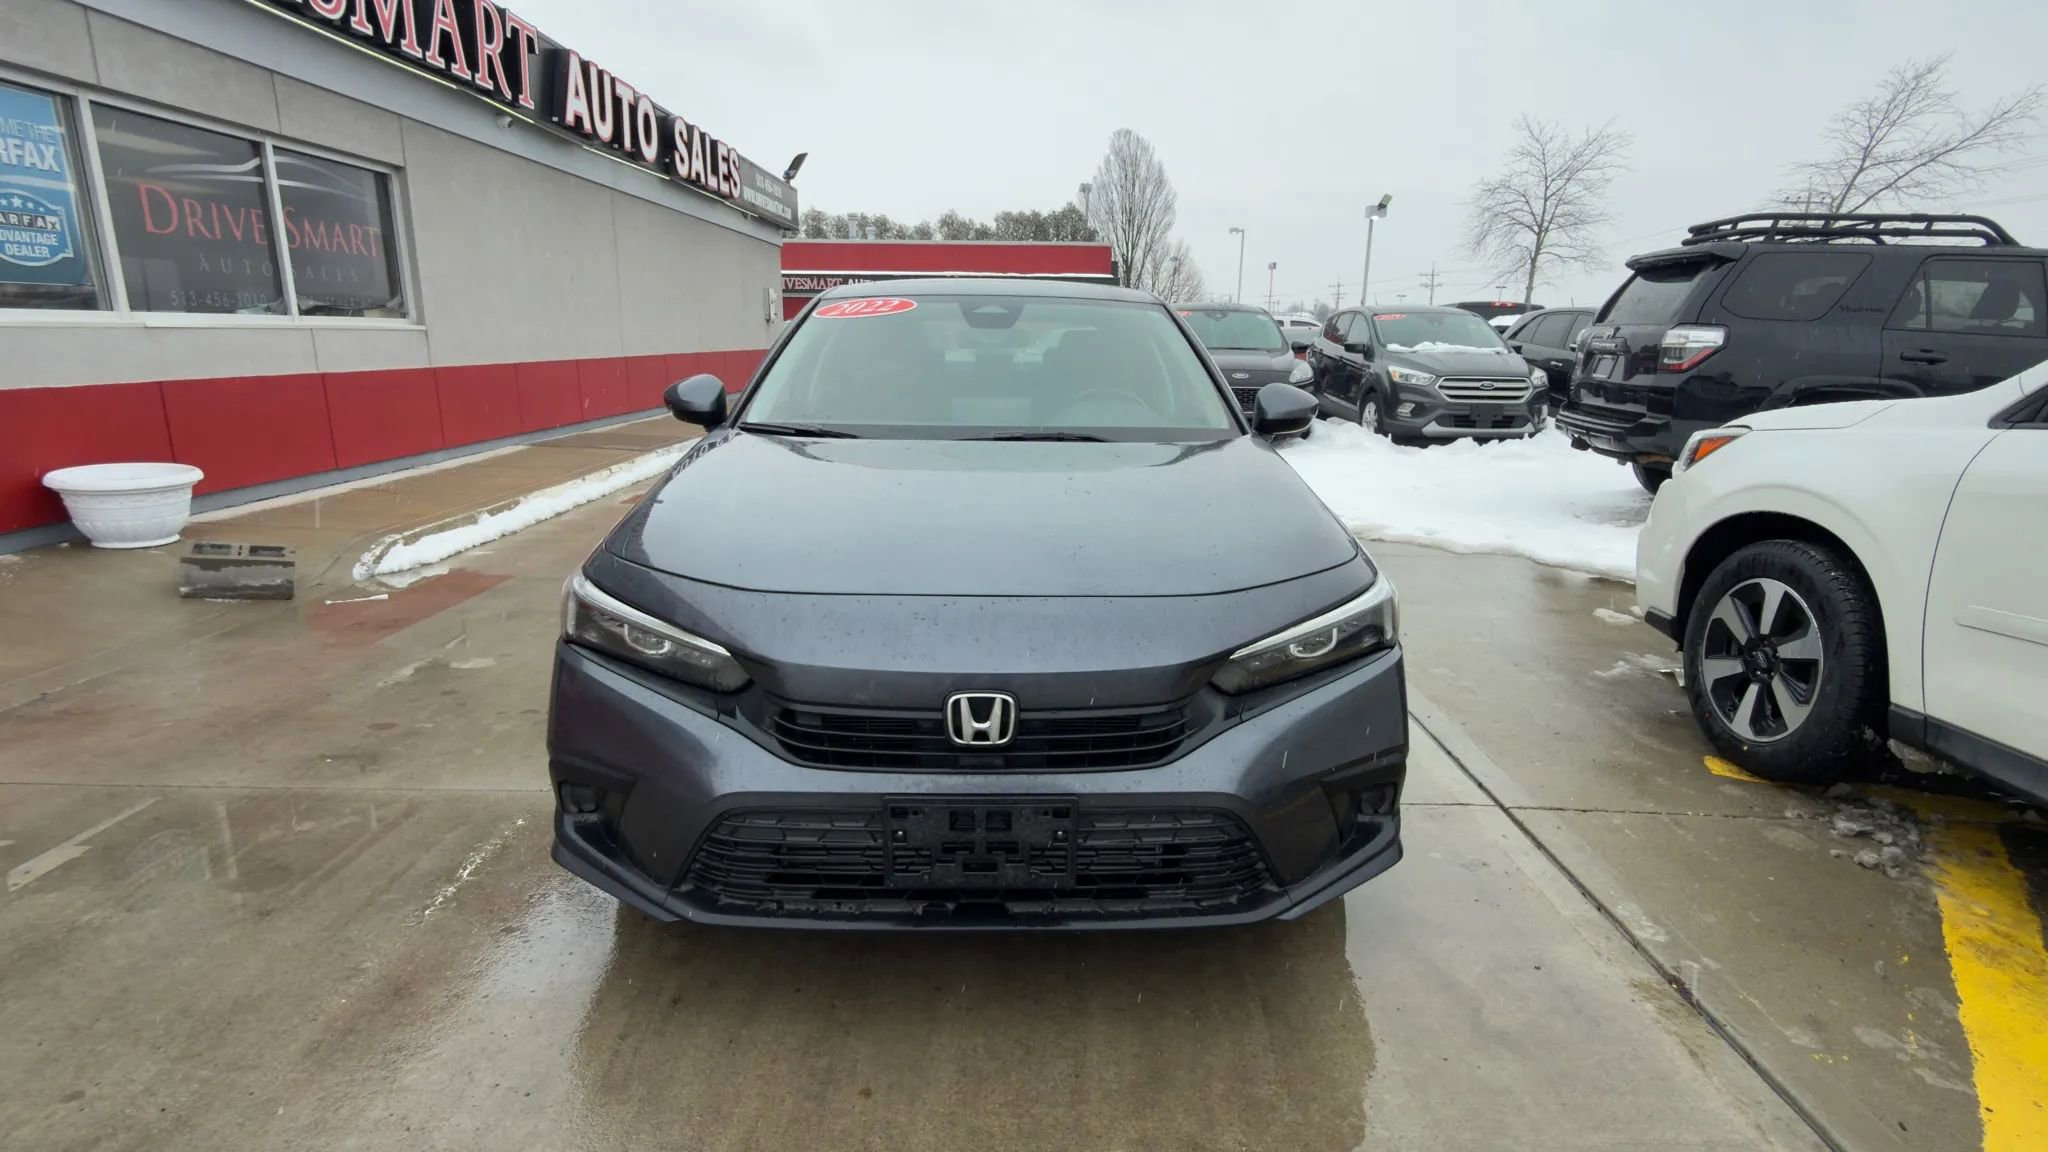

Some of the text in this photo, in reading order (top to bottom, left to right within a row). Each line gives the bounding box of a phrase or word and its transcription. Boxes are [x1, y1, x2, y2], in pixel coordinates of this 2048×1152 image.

[565, 49, 658, 163] AUTO
[674, 115, 741, 199] SALES
[4, 243, 50, 258] DEALER
[825, 300, 900, 316] 2022
